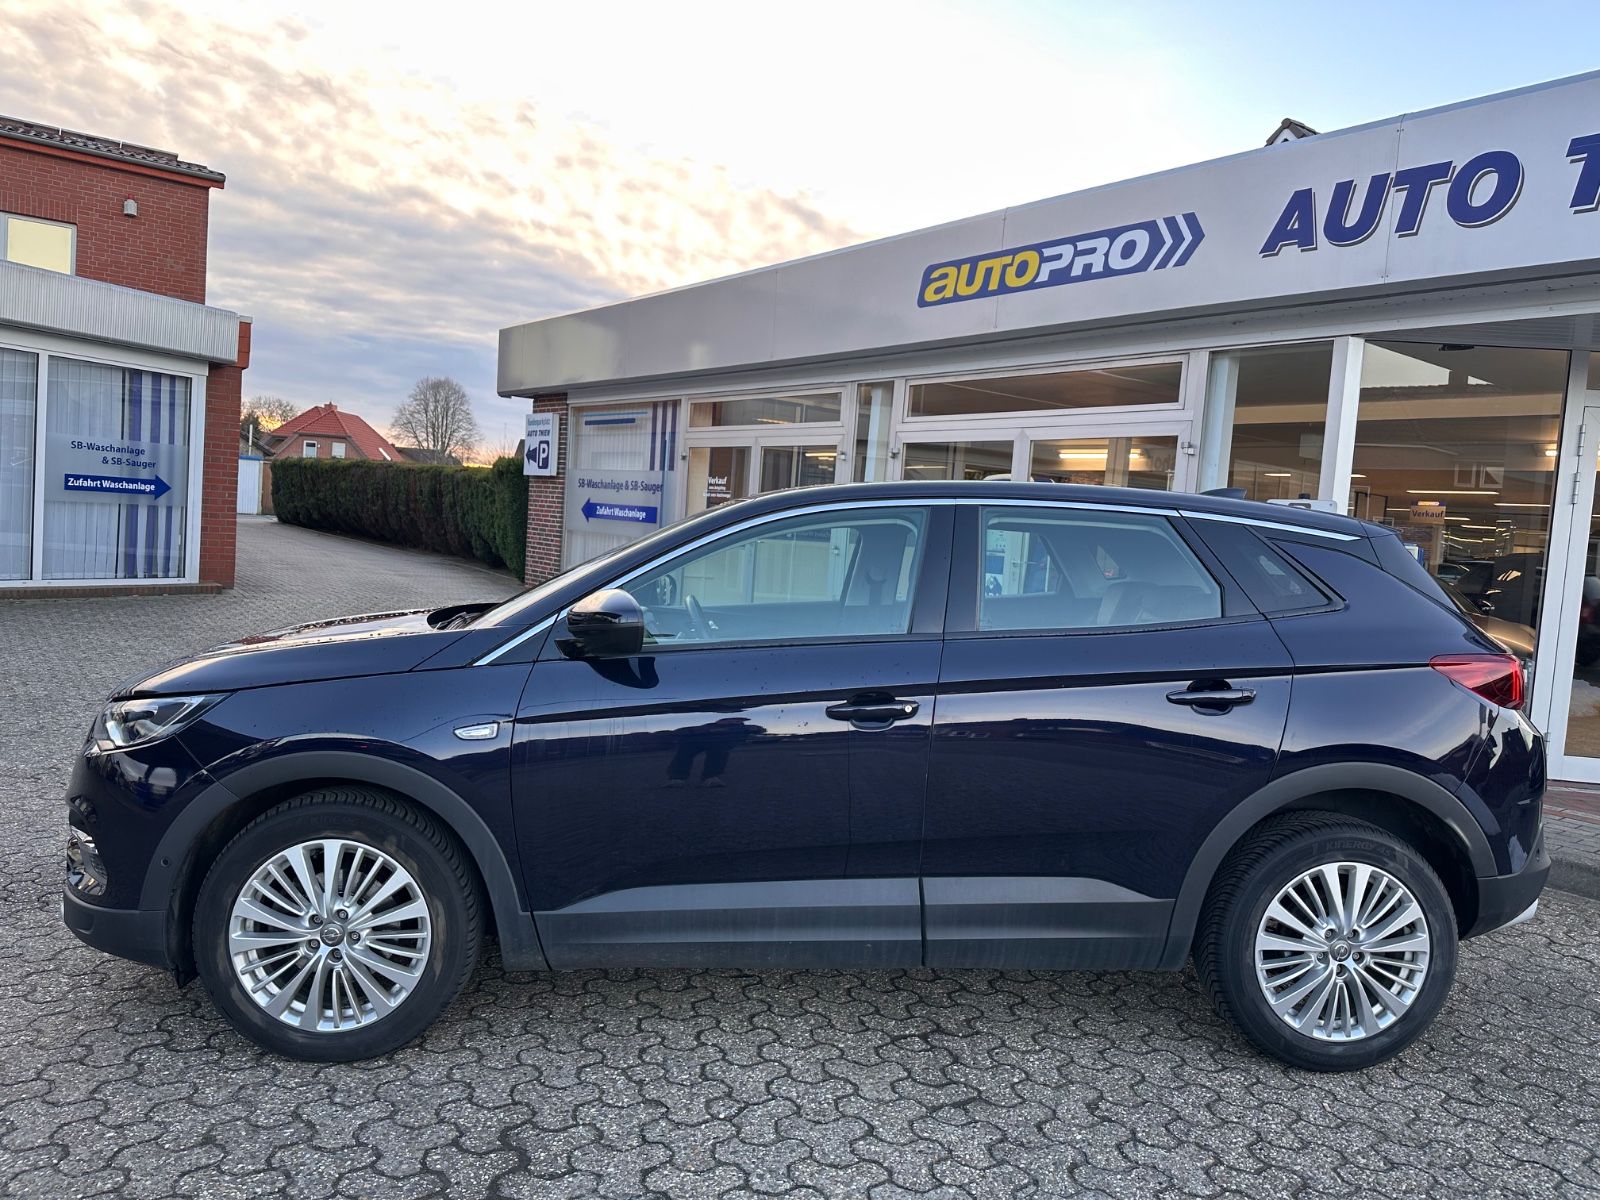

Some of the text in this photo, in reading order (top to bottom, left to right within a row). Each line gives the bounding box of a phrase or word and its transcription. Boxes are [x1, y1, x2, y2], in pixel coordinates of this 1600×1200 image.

[1258, 149, 1525, 258] AUTO
[70, 440, 146, 456] SB-Waschanlage
[101, 456, 157, 470] & SB-Sauger
[67, 477, 156, 492] Zufahrt Waschanlage
[577, 478, 624, 493] SB-Waschanlage
[595, 505, 647, 521] Zufahrt Waschanlage
[1411, 509, 1444, 519] Verkauf
